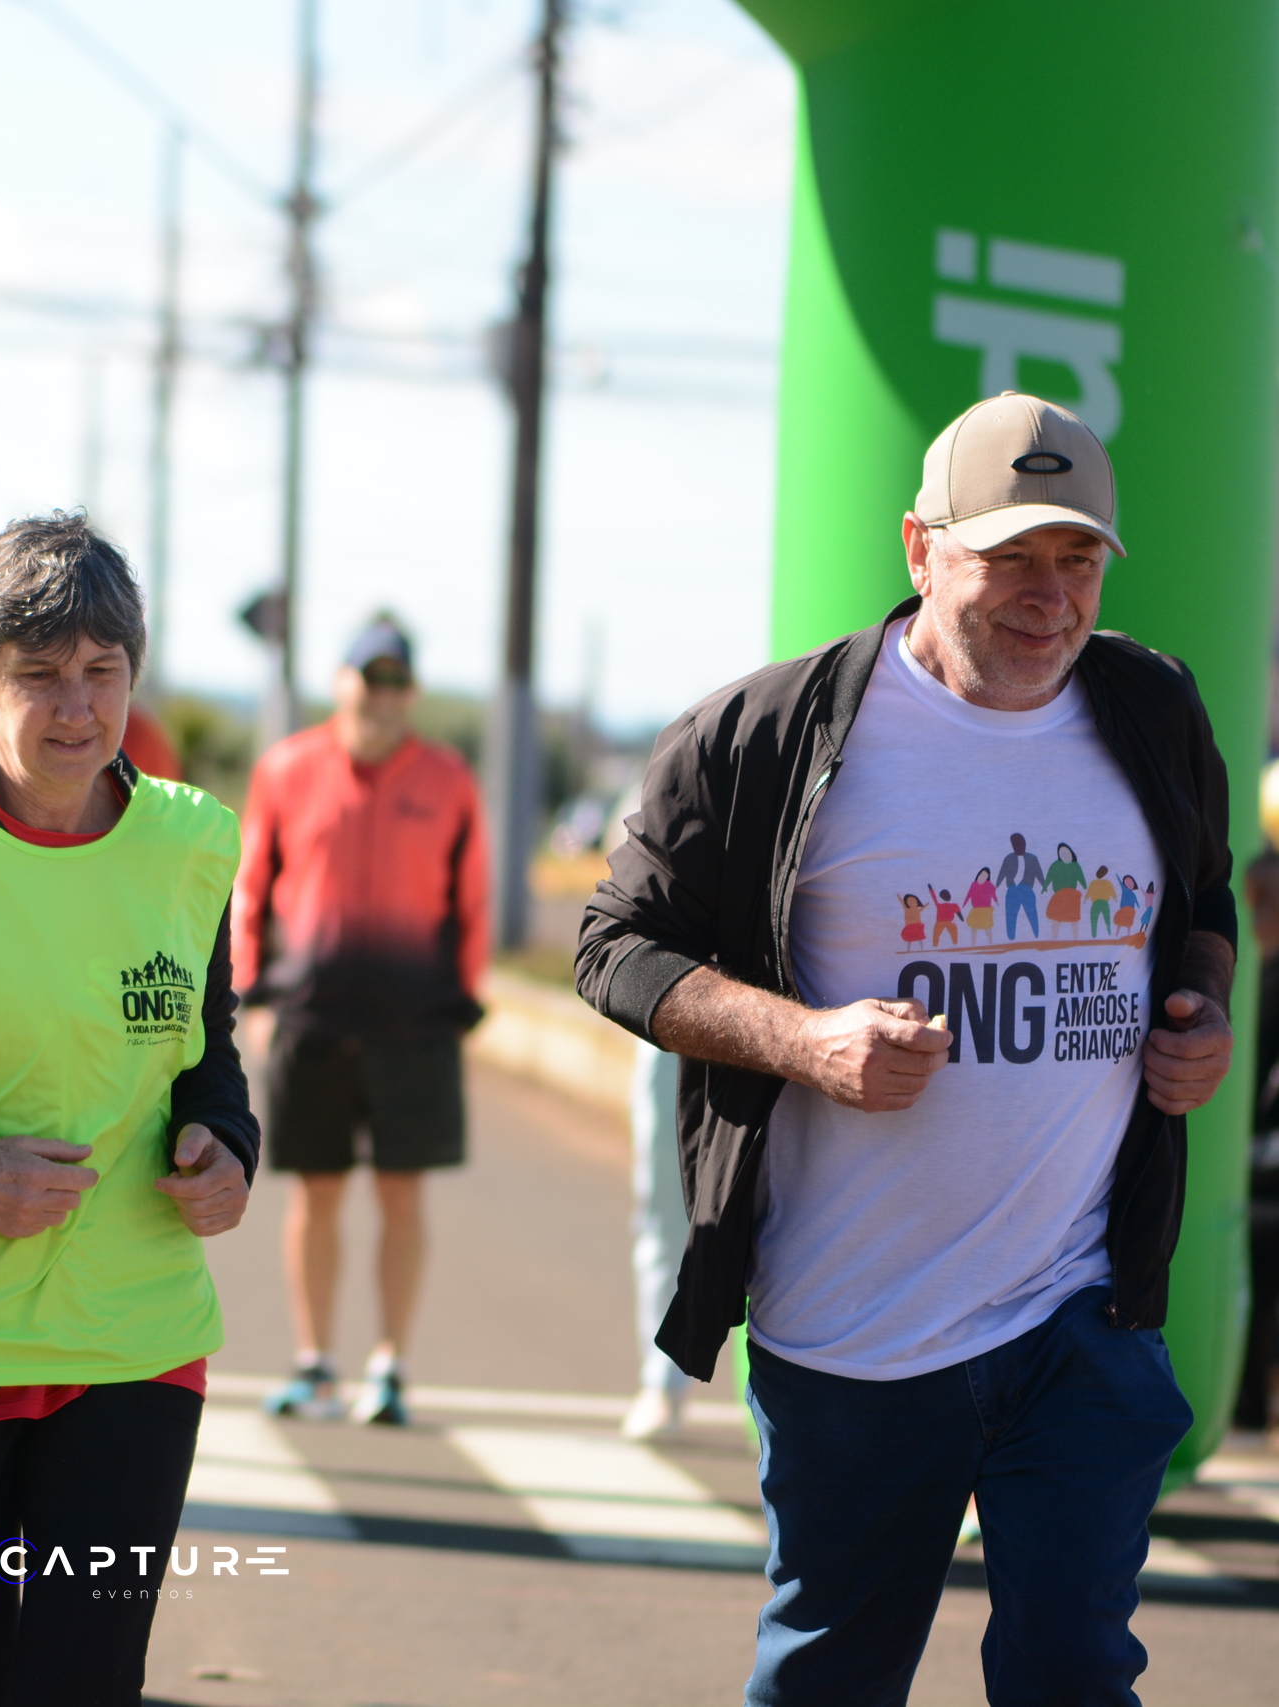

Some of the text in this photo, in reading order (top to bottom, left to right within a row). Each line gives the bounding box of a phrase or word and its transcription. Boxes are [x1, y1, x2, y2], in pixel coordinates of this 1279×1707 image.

[933, 226, 1125, 446] di
[1056, 960, 1120, 994] ENTRE
[122, 990, 174, 1021] ONG
[1055, 992, 1139, 1028] AMIGOS E
[132, 1025, 150, 1034] VIDA
[1054, 1026, 1141, 1065] CRIANÇAS
